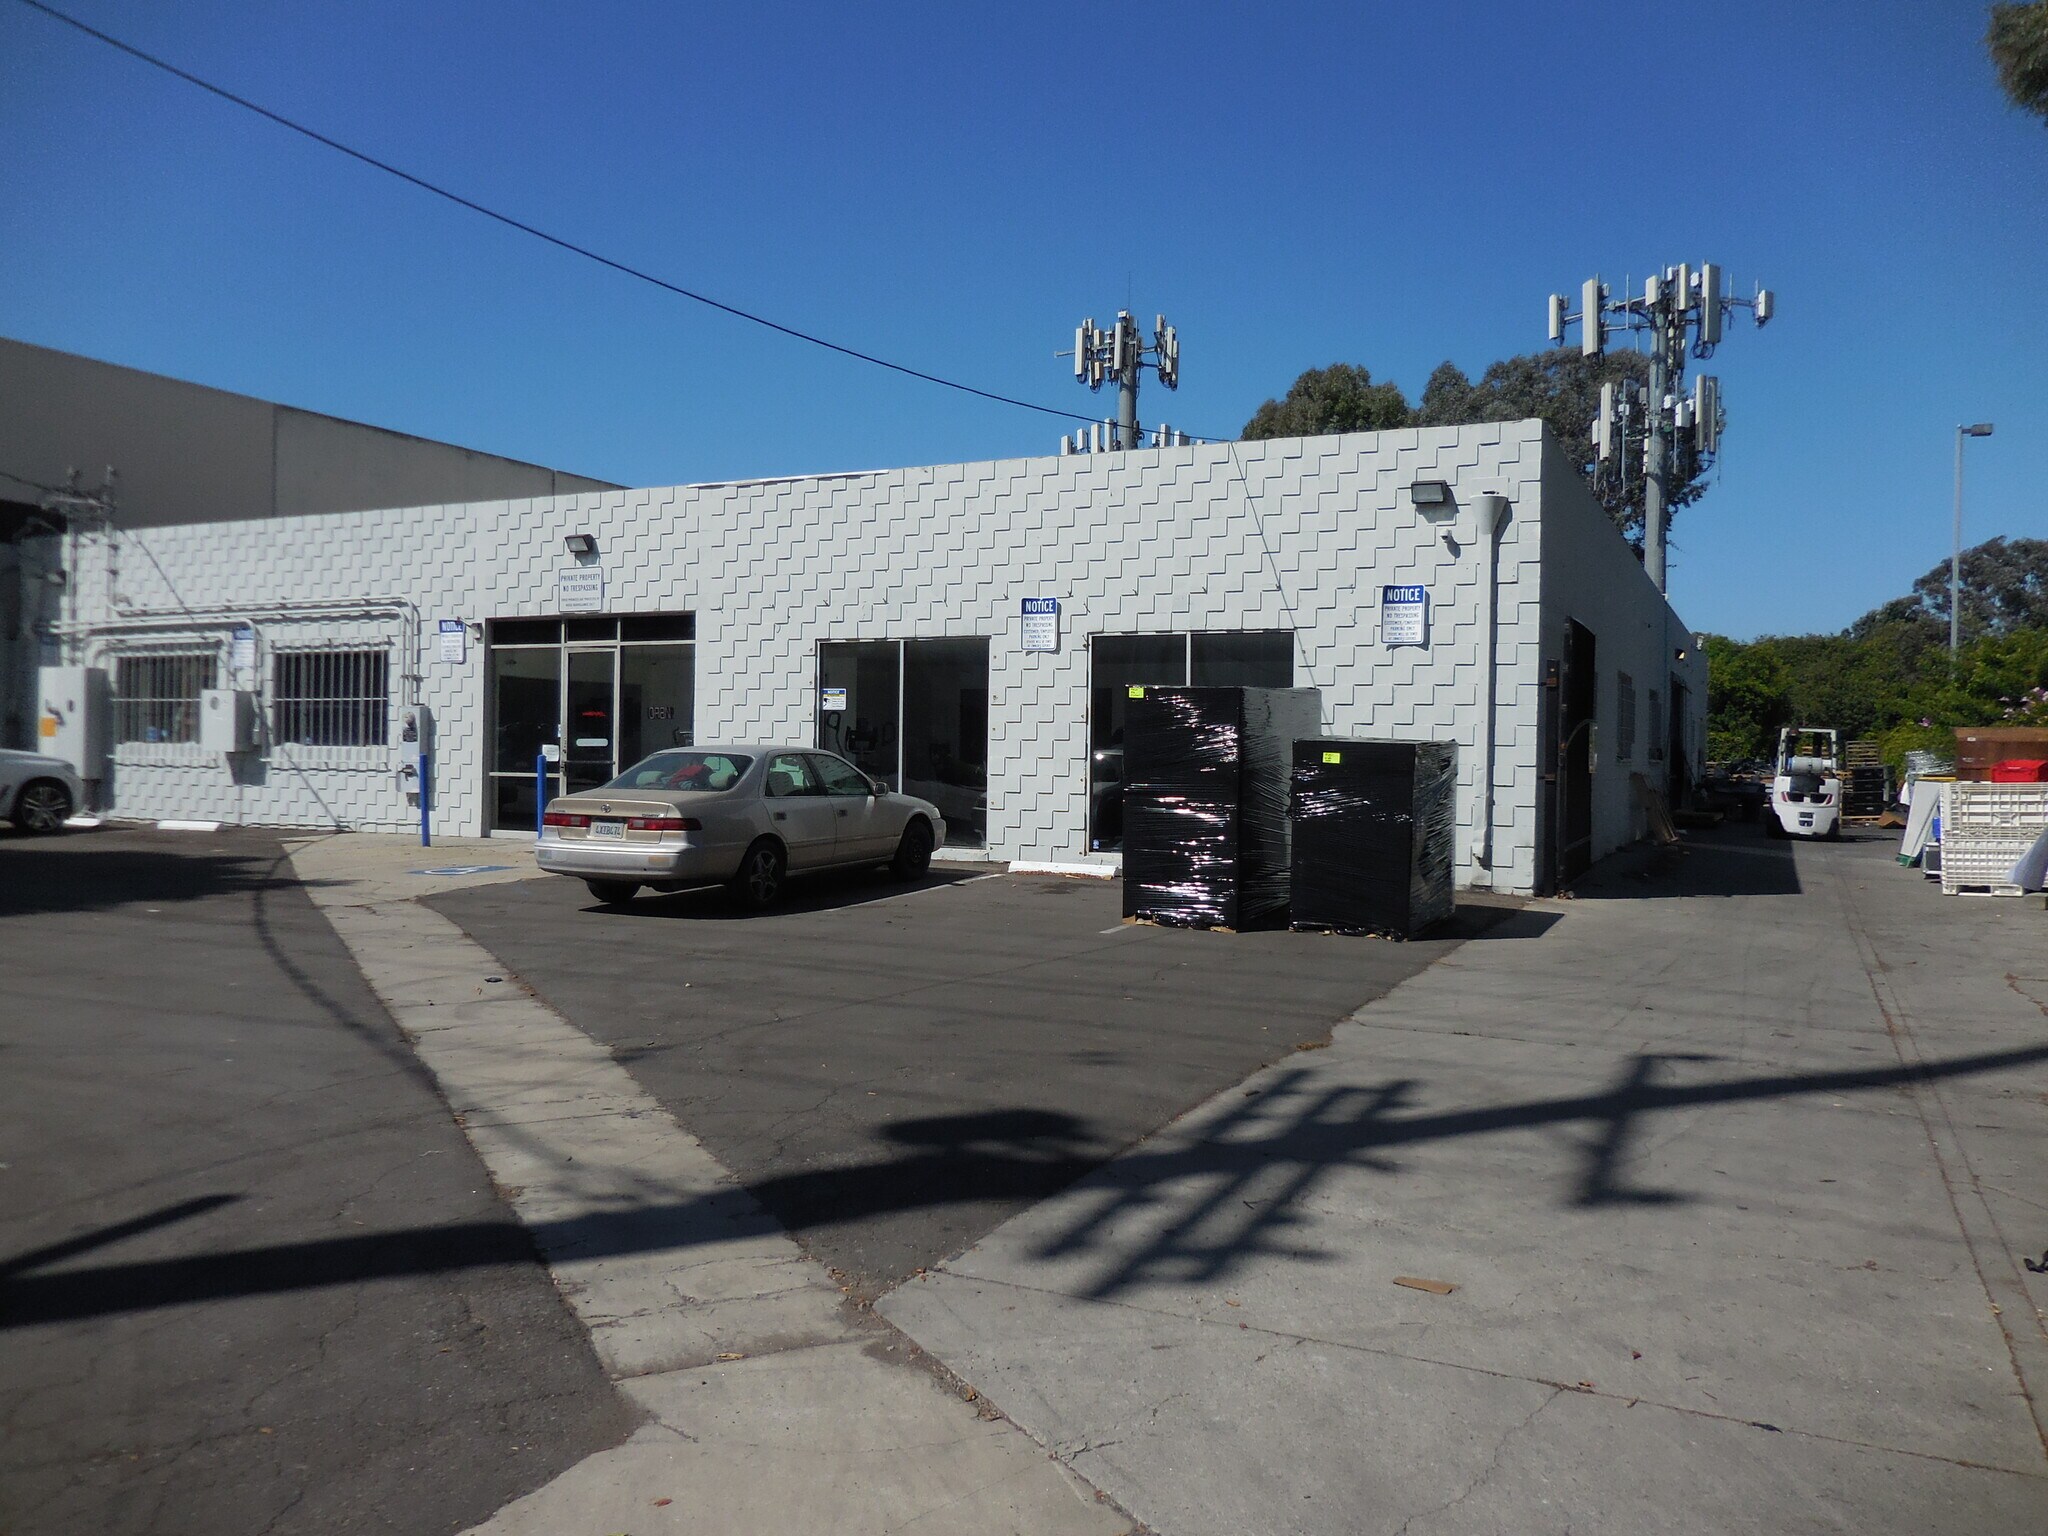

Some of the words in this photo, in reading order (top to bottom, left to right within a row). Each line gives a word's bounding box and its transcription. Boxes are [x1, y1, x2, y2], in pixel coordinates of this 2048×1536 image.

[561, 574, 578, 582] PRIVATE
[579, 573, 600, 581] PROPERTY
[571, 583, 598, 592] TRESPASSING
[1387, 588, 1420, 601] NOTICE
[1026, 600, 1054, 612] NOTICE
